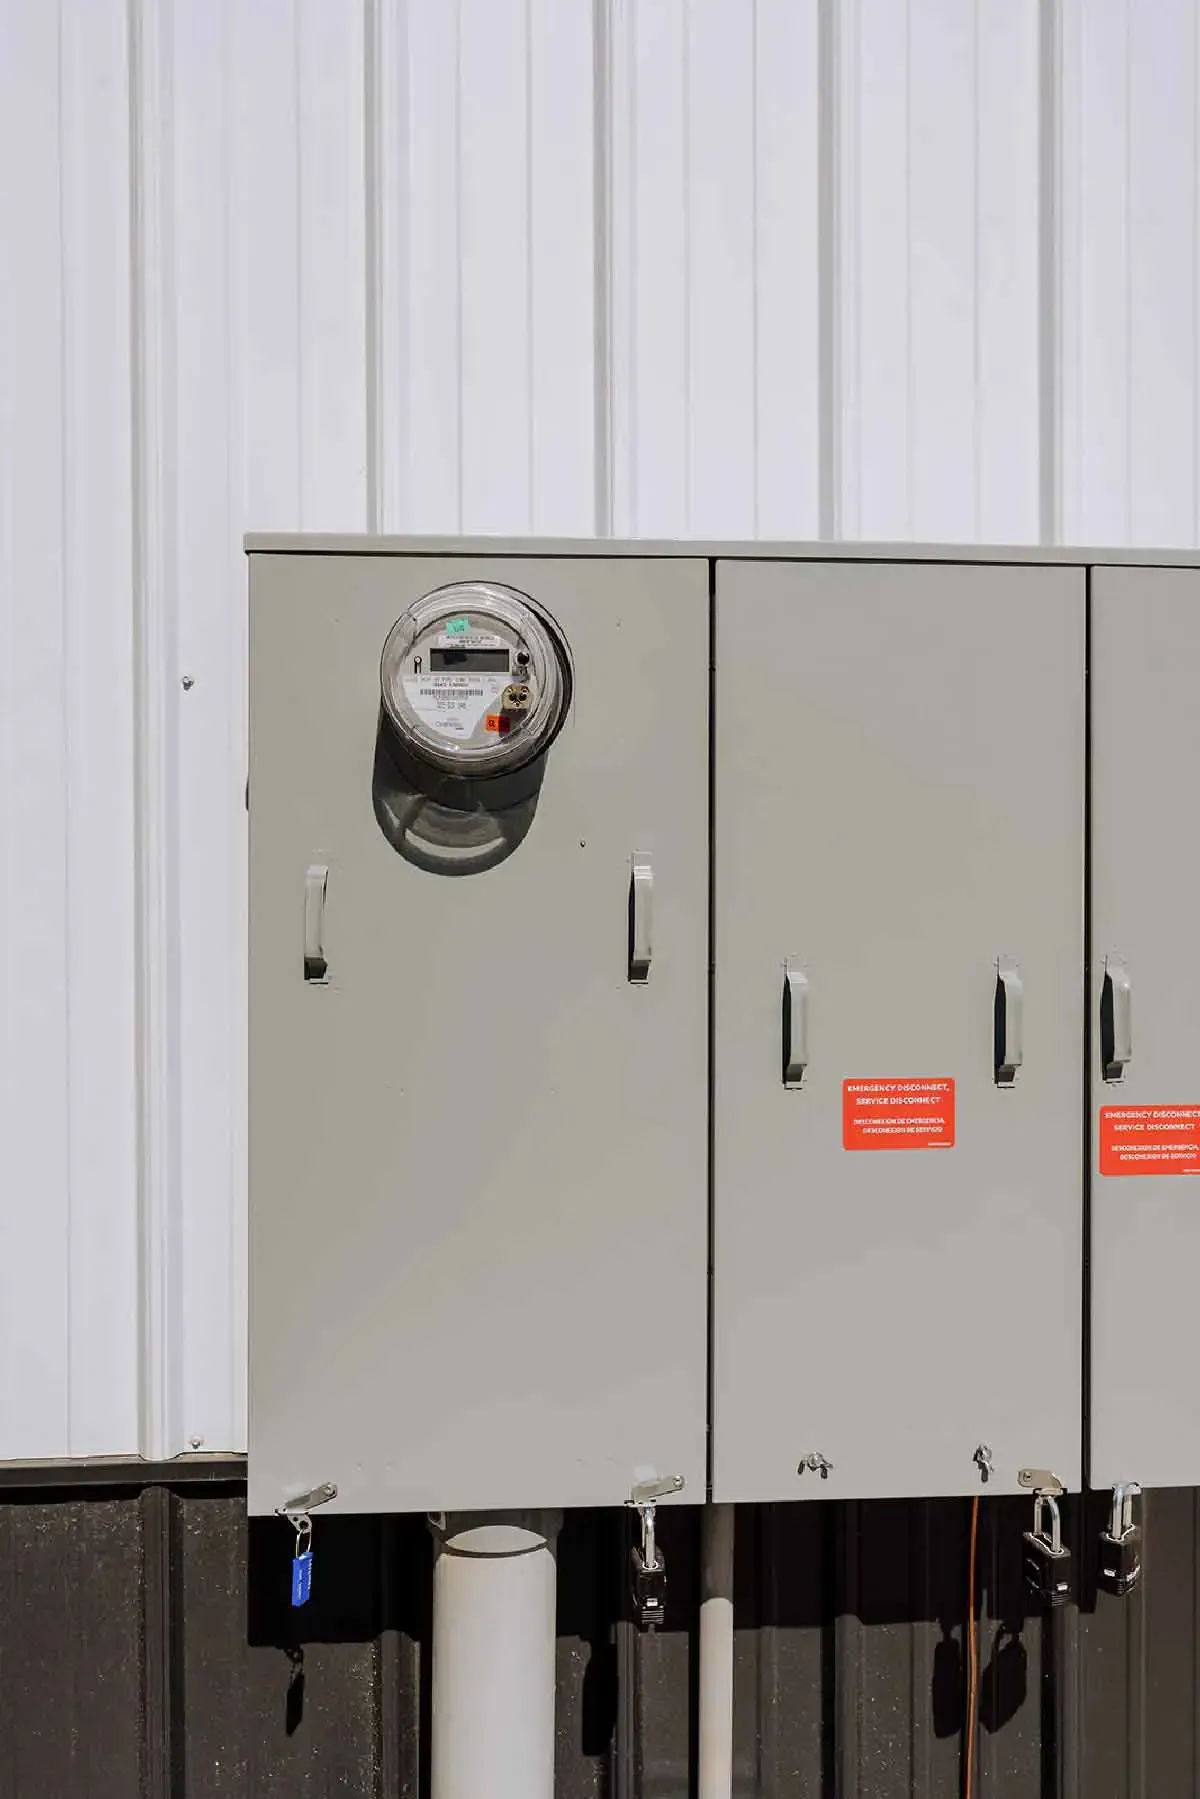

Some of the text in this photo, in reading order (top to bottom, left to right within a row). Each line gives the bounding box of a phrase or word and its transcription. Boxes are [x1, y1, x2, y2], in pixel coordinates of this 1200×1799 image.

[848, 1084, 896, 1092] EMERGENCY
[856, 1096, 941, 1105] SERVICE DISCONNECT
[1105, 1111, 1152, 1119] EMERGENCY
